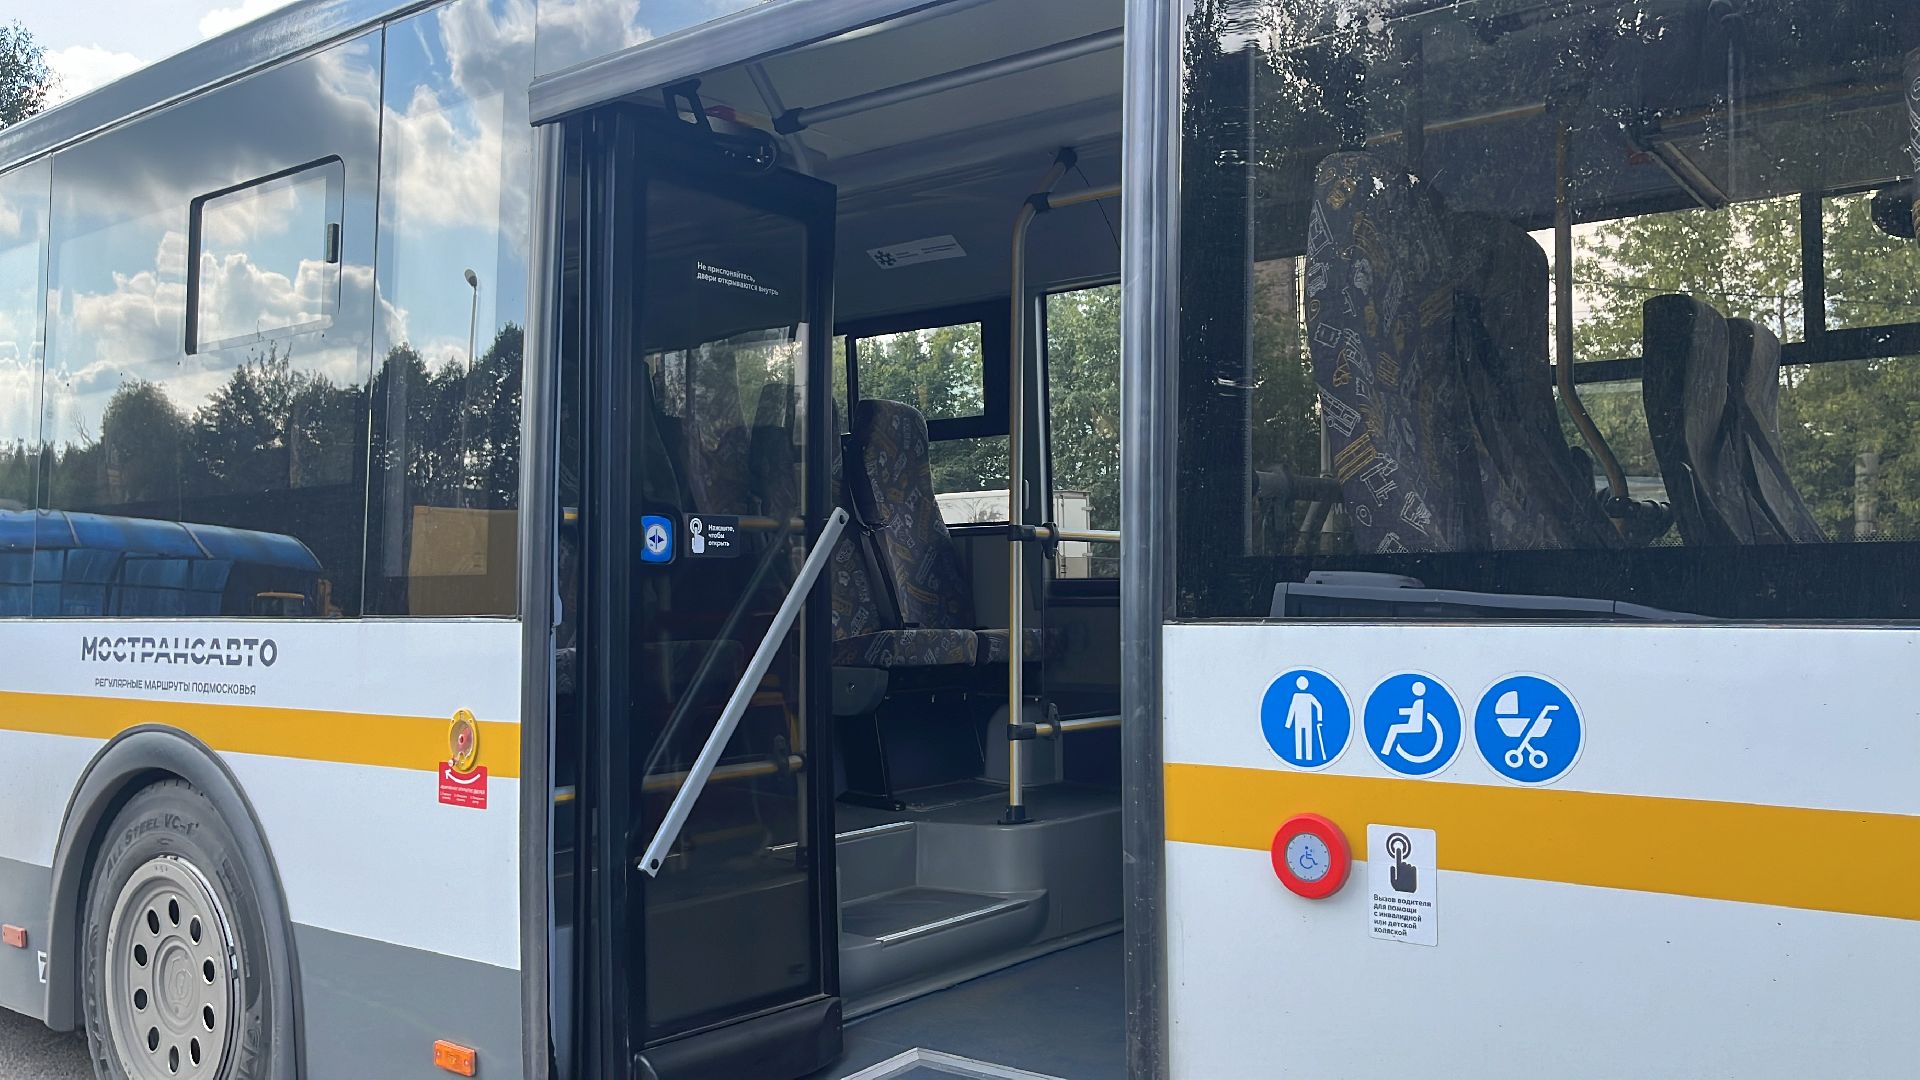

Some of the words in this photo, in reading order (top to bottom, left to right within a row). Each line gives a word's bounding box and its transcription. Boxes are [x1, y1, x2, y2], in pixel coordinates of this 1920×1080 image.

[697, 261, 707, 271] Не
[697, 272, 717, 282] двери
[717, 277, 757, 291] открываются
[758, 285, 779, 296] внутрь
[708, 531, 725, 539] чтобы
[708, 540, 730, 548] открыть
[81, 636, 278, 667] МОСТРАНСАВТО
[95, 678, 143, 690] РЕГУЛЯРНЫЕ
[144, 680, 191, 693] МАРШРУТЫ
[191, 682, 256, 696] ПОДМОСКОВЬЯ
[125, 818, 160, 845] STEEL
[1373, 894, 1396, 903] Вызов
[1397, 898, 1432, 907] водителя
[1387, 905, 1417, 914] помощи
[1379, 912, 1421, 922] инвалидной
[1388, 921, 1417, 930] детской
[1374, 927, 1407, 936] коляской
